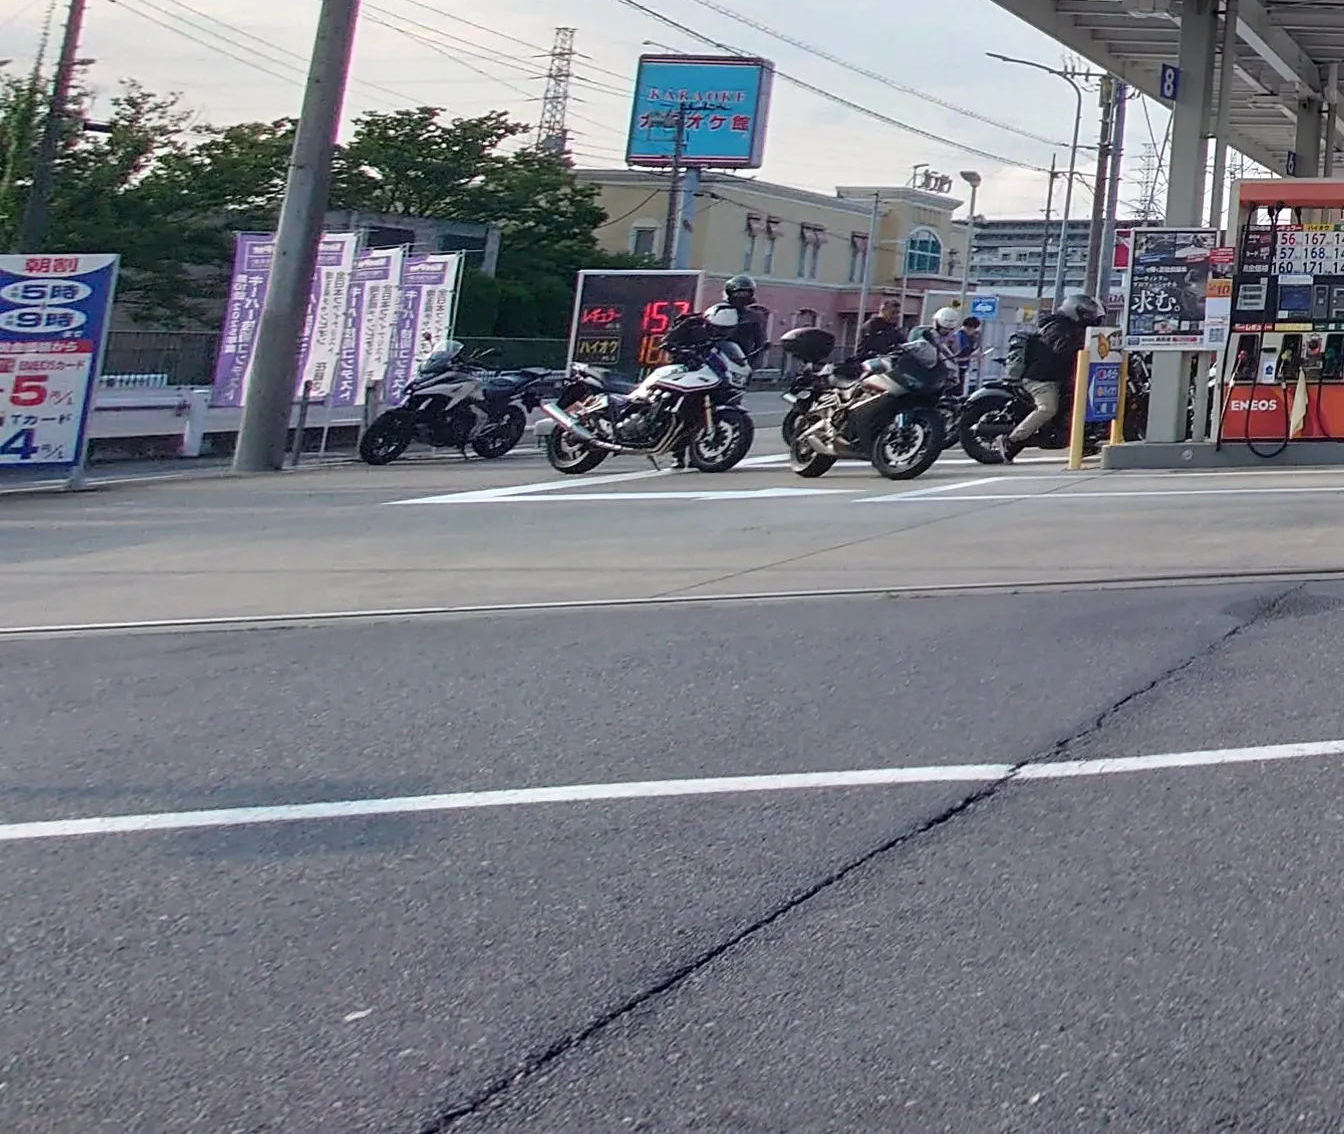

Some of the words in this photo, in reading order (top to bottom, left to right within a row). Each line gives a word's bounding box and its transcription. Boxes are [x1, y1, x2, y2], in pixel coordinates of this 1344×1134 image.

[1163, 68, 1175, 97] 8
[650, 88, 745, 102] KARAOKE
[640, 114, 750, 131] オケ館
[1287, 154, 1295, 174] 6
[1278, 233, 1296, 245] 56
[1304, 234, 1327, 245] 167
[1278, 248, 1295, 259] 57
[1304, 248, 1325, 259] 168
[25, 257, 79, 274] 朝割
[1303, 262, 1324, 273] 171
[21, 284, 79, 300] 5時
[1131, 289, 1181, 313] 求む。
[16, 312, 74, 327] 9時
[580, 340, 618, 353] ハイオク
[10, 375, 48, 407] 5
[1231, 399, 1277, 411] ENEOS
[0, 428, 39, 460] 4
